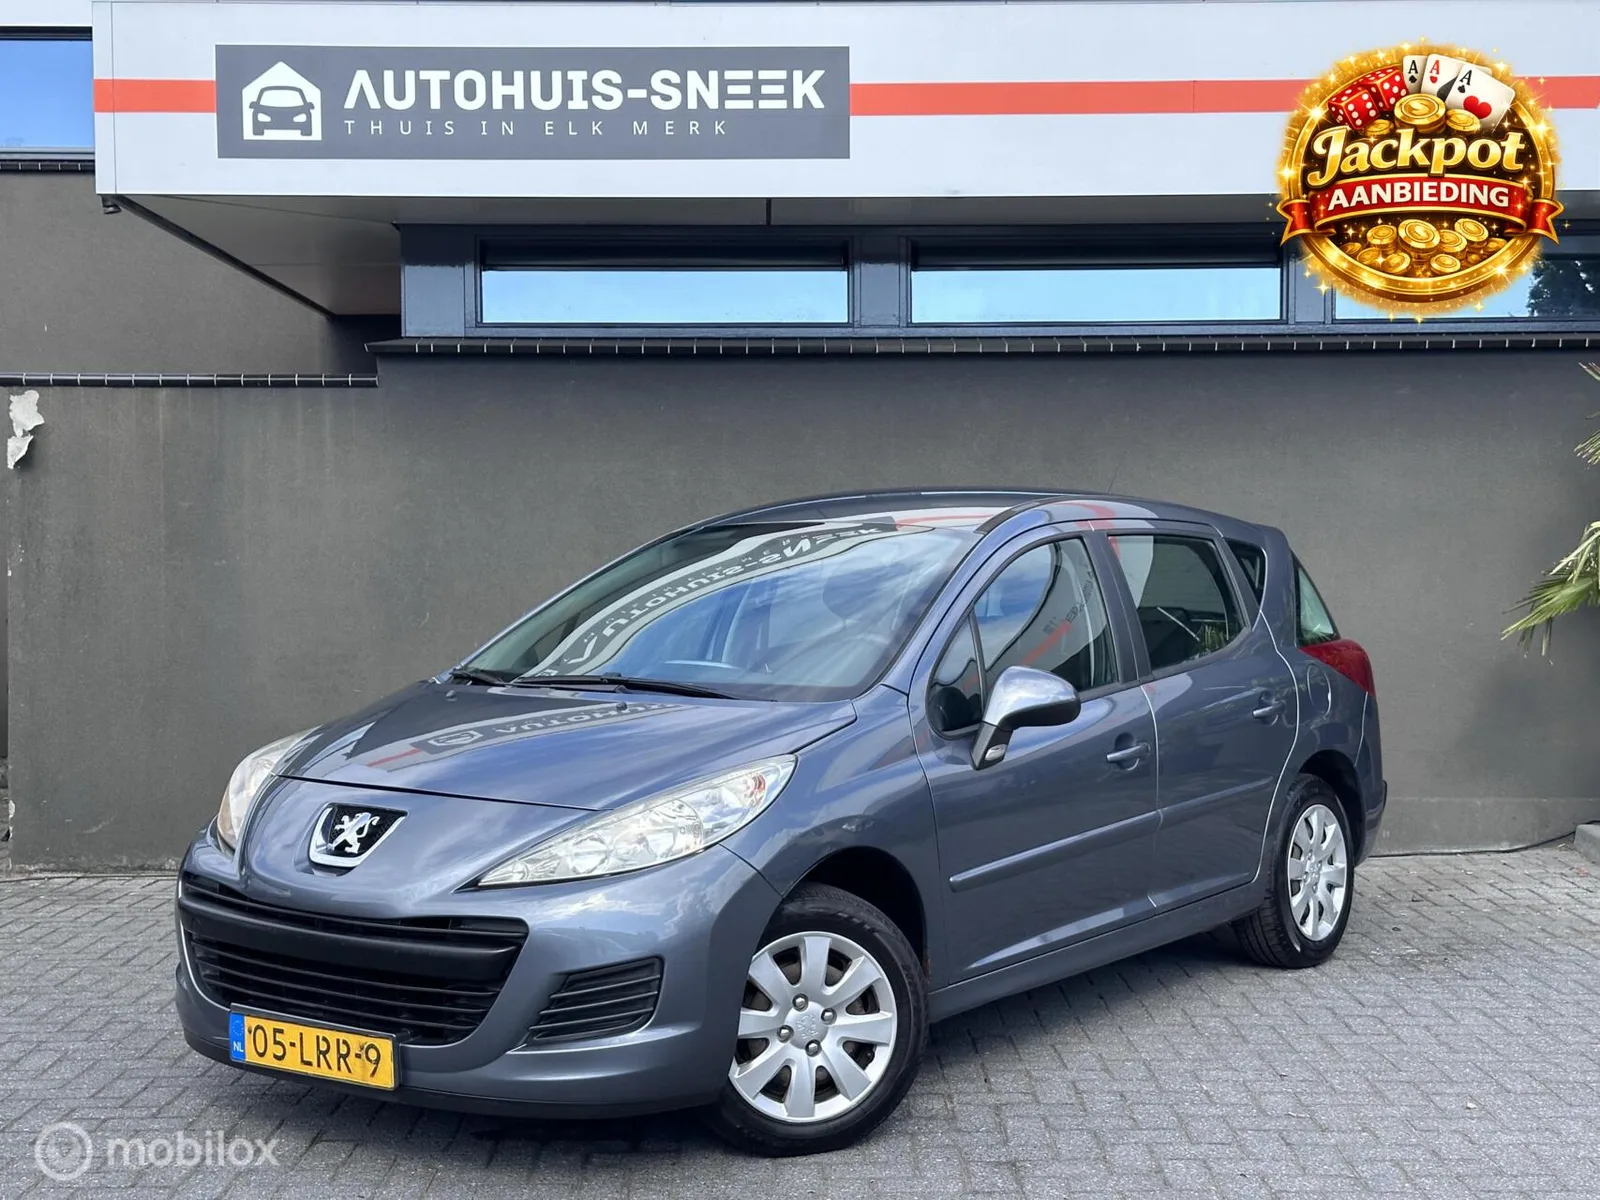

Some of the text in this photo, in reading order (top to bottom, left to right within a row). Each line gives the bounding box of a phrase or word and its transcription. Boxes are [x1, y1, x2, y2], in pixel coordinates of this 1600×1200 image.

[343, 69, 826, 111] AUTOHUIS-SNEEK
[344, 120, 727, 136] THUIS IN ELK MERK
[232, 1041, 244, 1053] NL
[252, 1024, 382, 1078] 05-LRR-9
